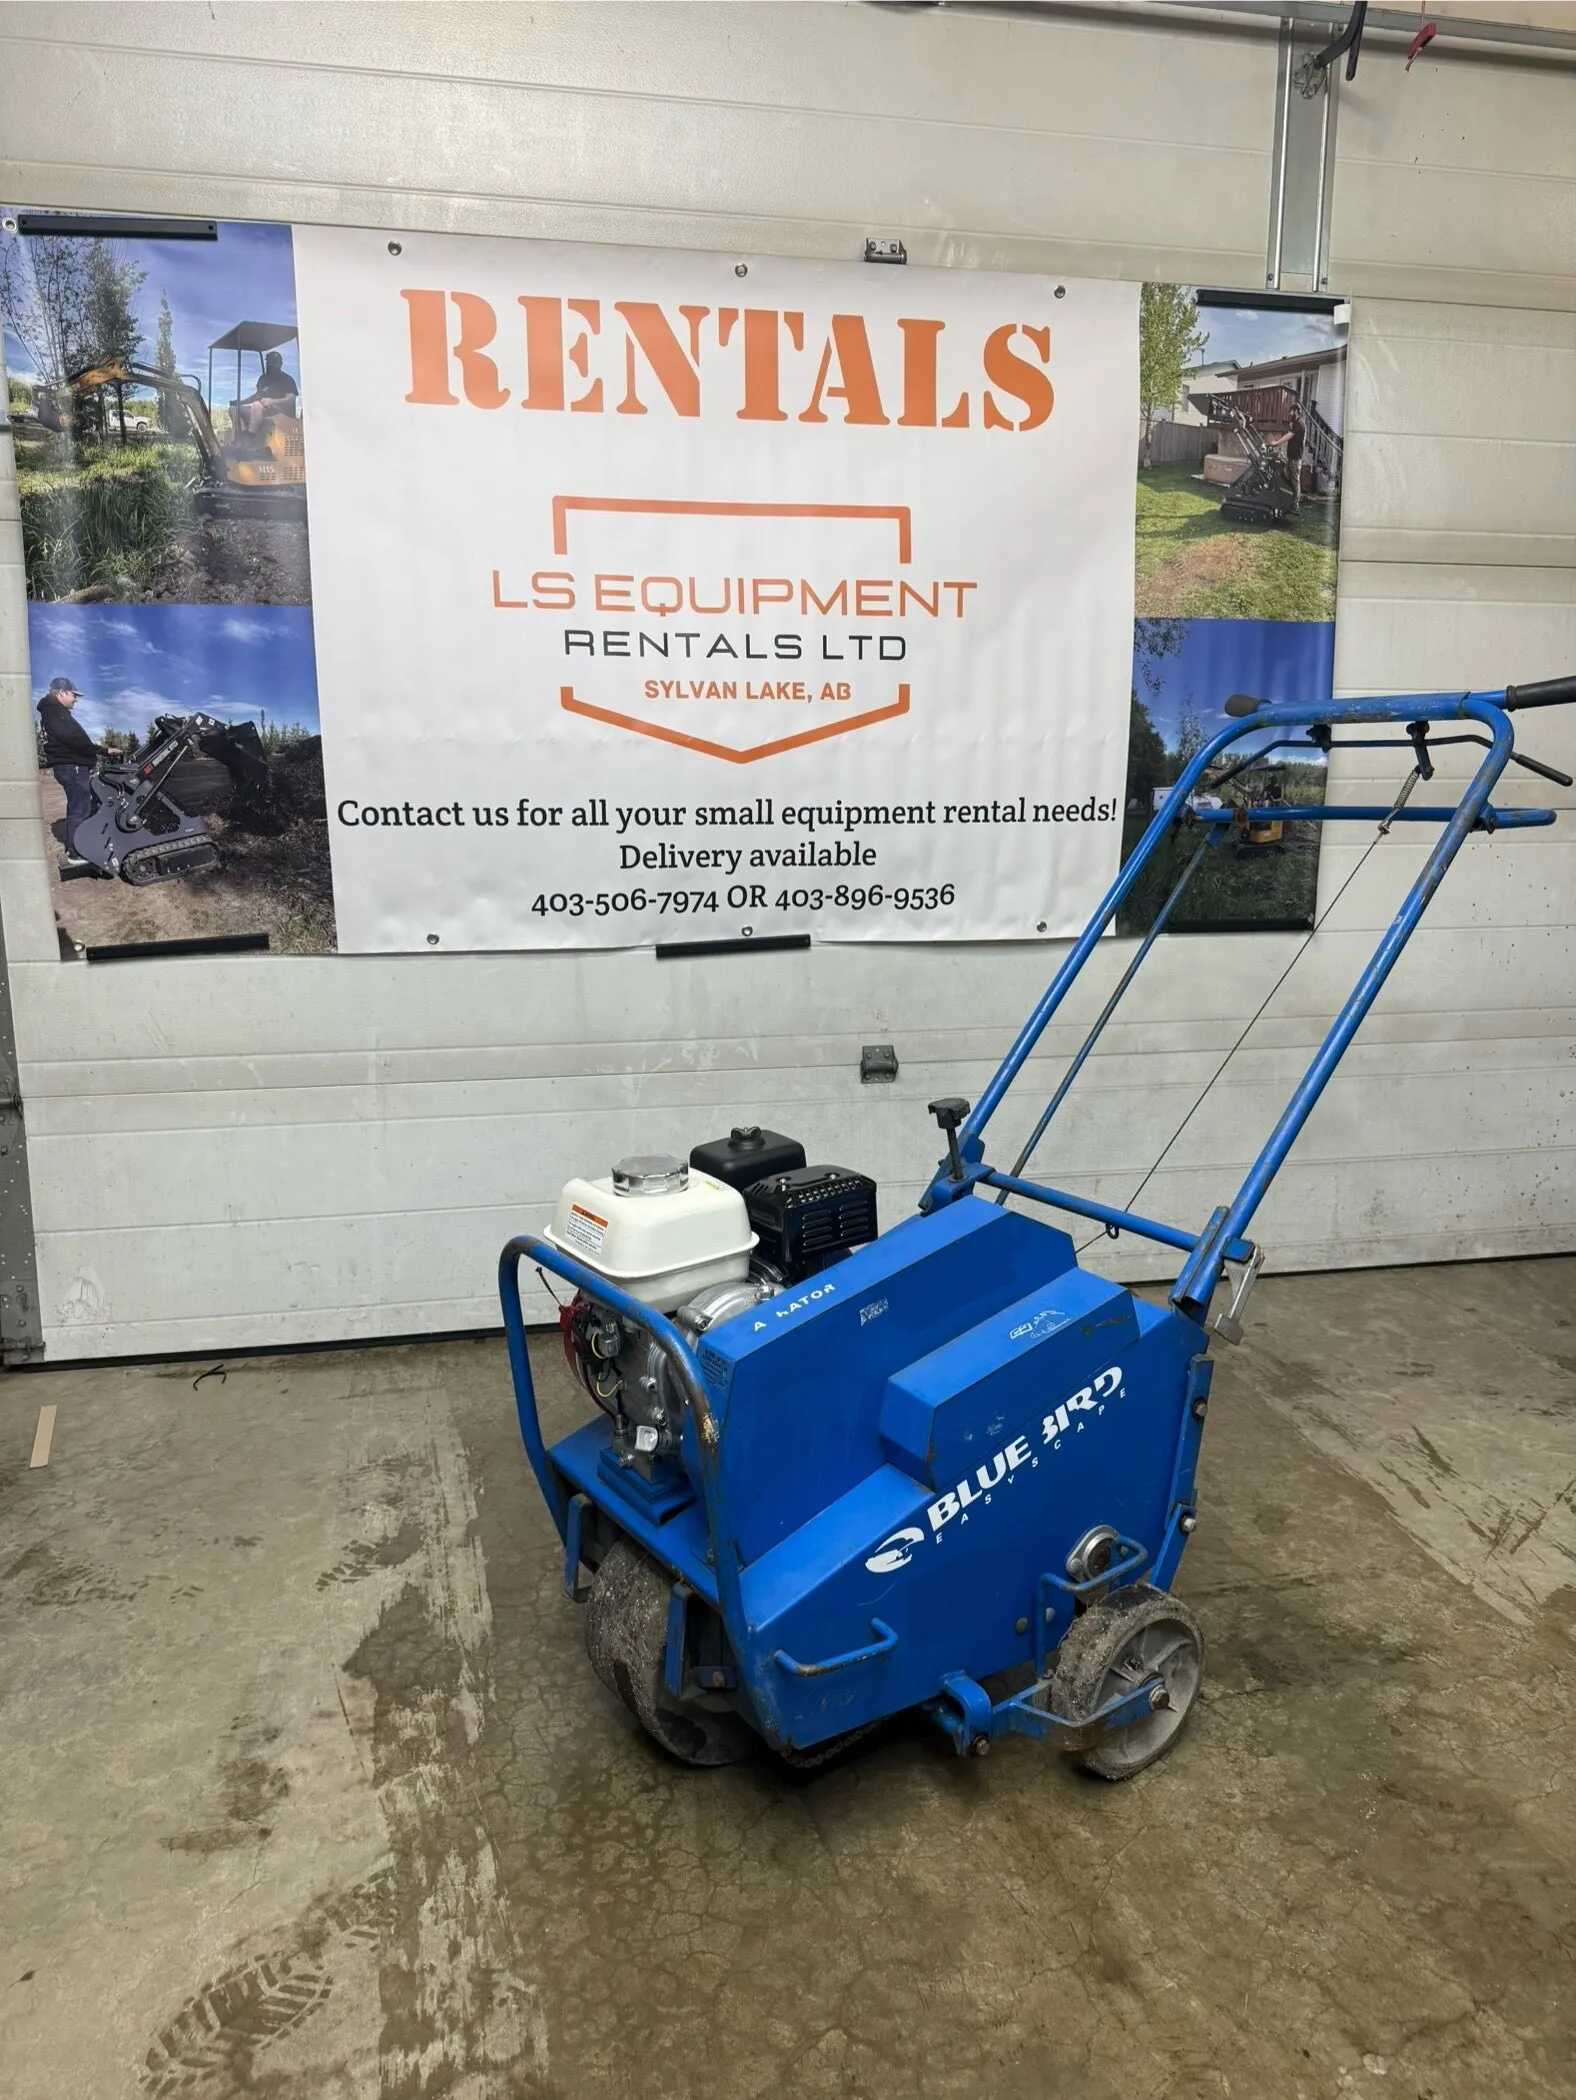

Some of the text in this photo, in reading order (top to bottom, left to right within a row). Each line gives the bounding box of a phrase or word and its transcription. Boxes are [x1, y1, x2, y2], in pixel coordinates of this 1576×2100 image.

[400, 288, 1055, 432] RENTALS
[492, 570, 978, 619] LS EQUIPMENT
[564, 629, 907, 662] RENTALS LTD
[644, 679, 852, 703] SYLVAN LAKE, AB
[337, 795, 1118, 835] Contact us for all your small equipment rental needs!
[619, 840, 877, 876] Delivery available
[530, 882, 956, 917] 403-506-7974 OR 403-896-9536
[926, 1366, 1123, 1532] BLUE BIRD
